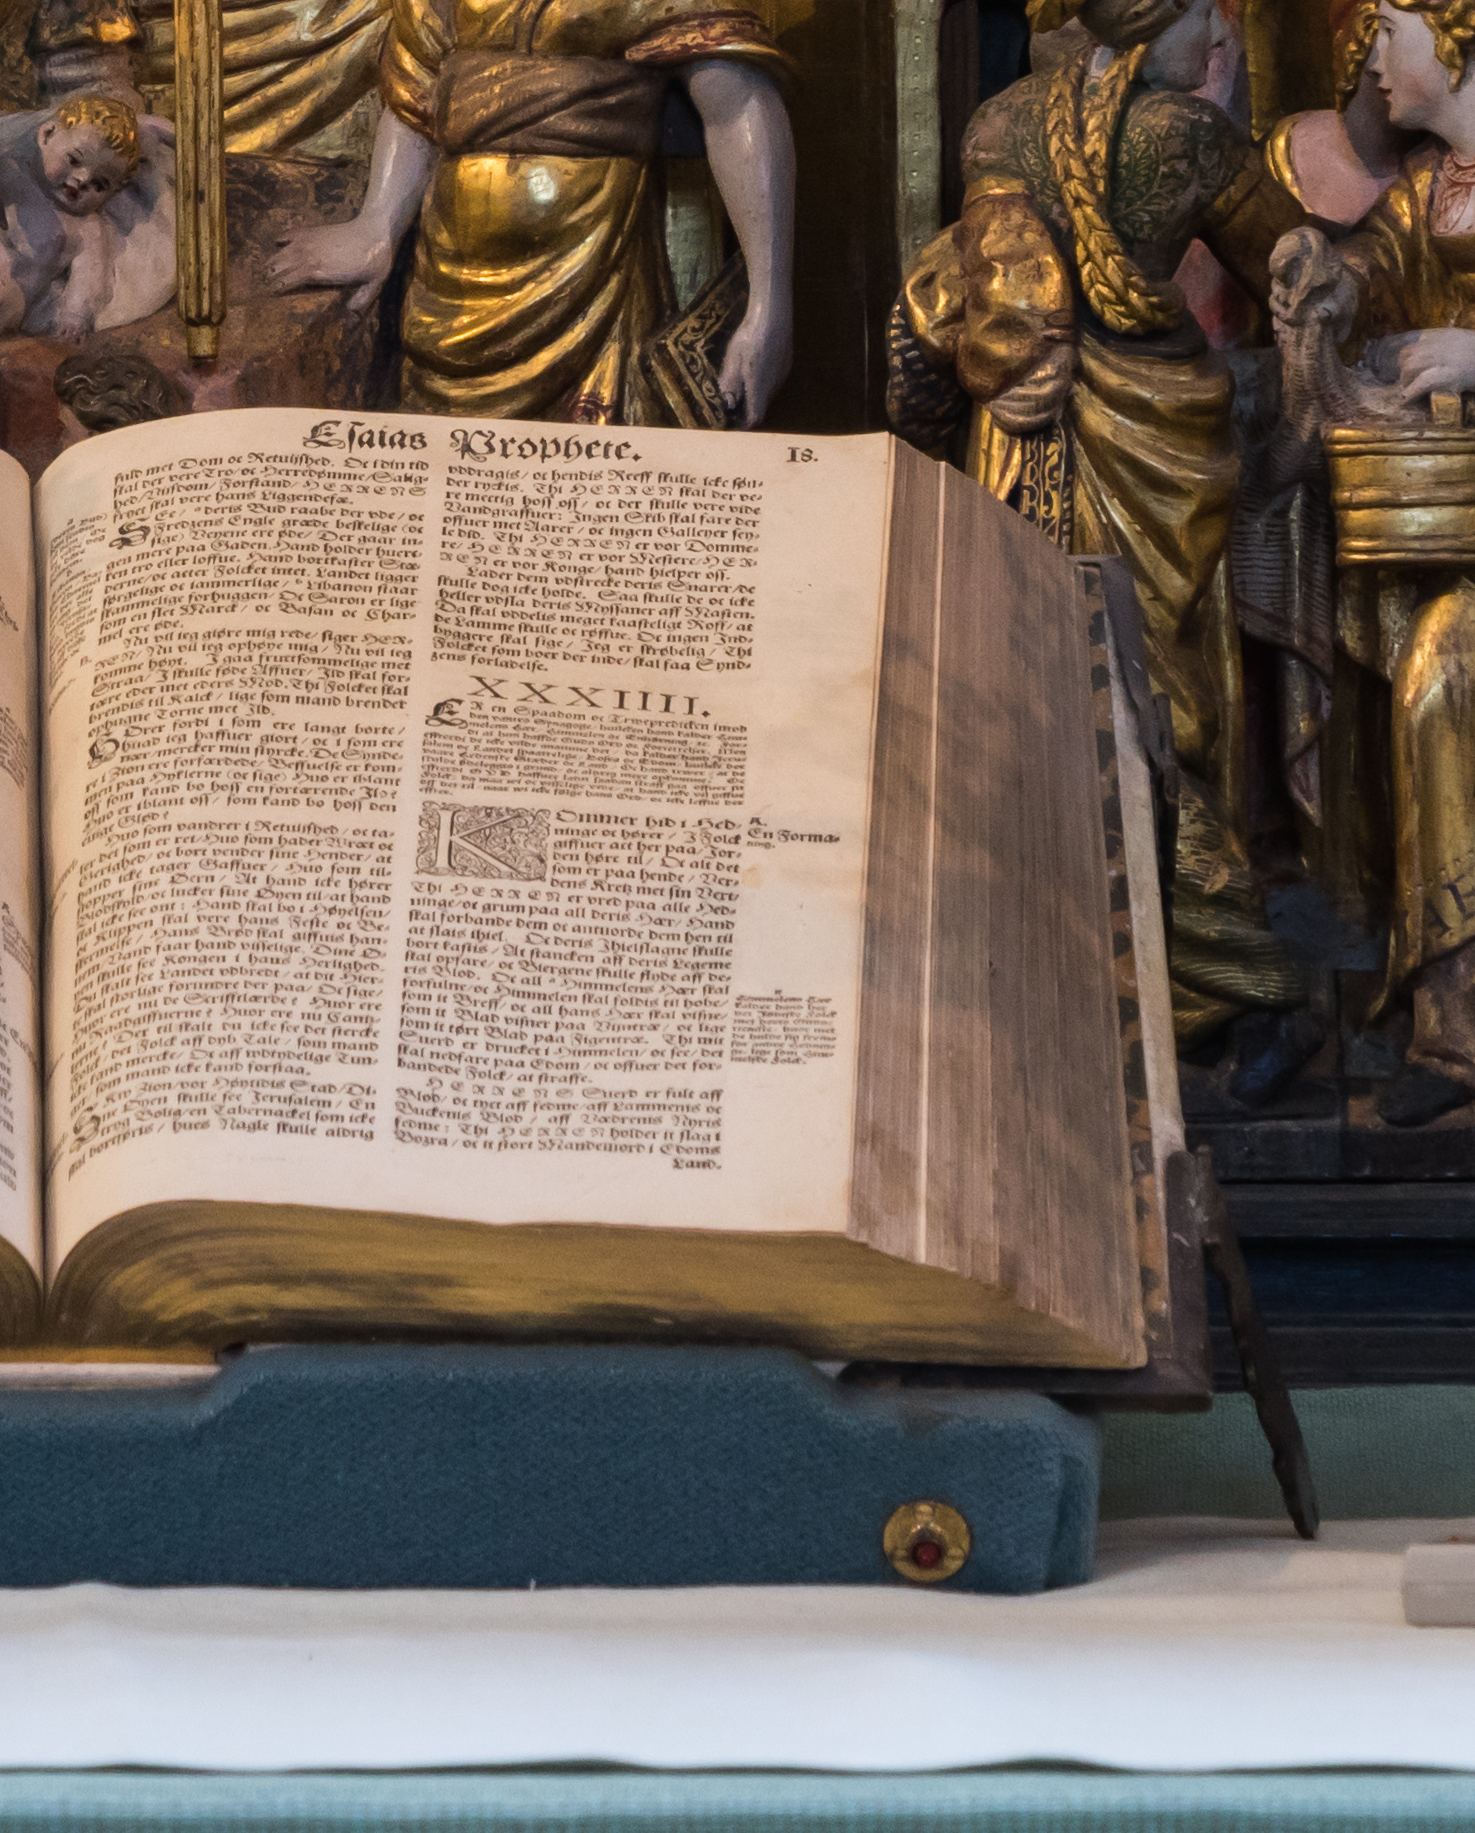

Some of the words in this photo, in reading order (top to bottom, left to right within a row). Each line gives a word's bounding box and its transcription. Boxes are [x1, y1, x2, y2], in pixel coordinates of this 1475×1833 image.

[178, 457, 223, 469] Dom
[450, 429, 642, 464] Prophete.
[468, 675, 711, 720] XXXIIII.
